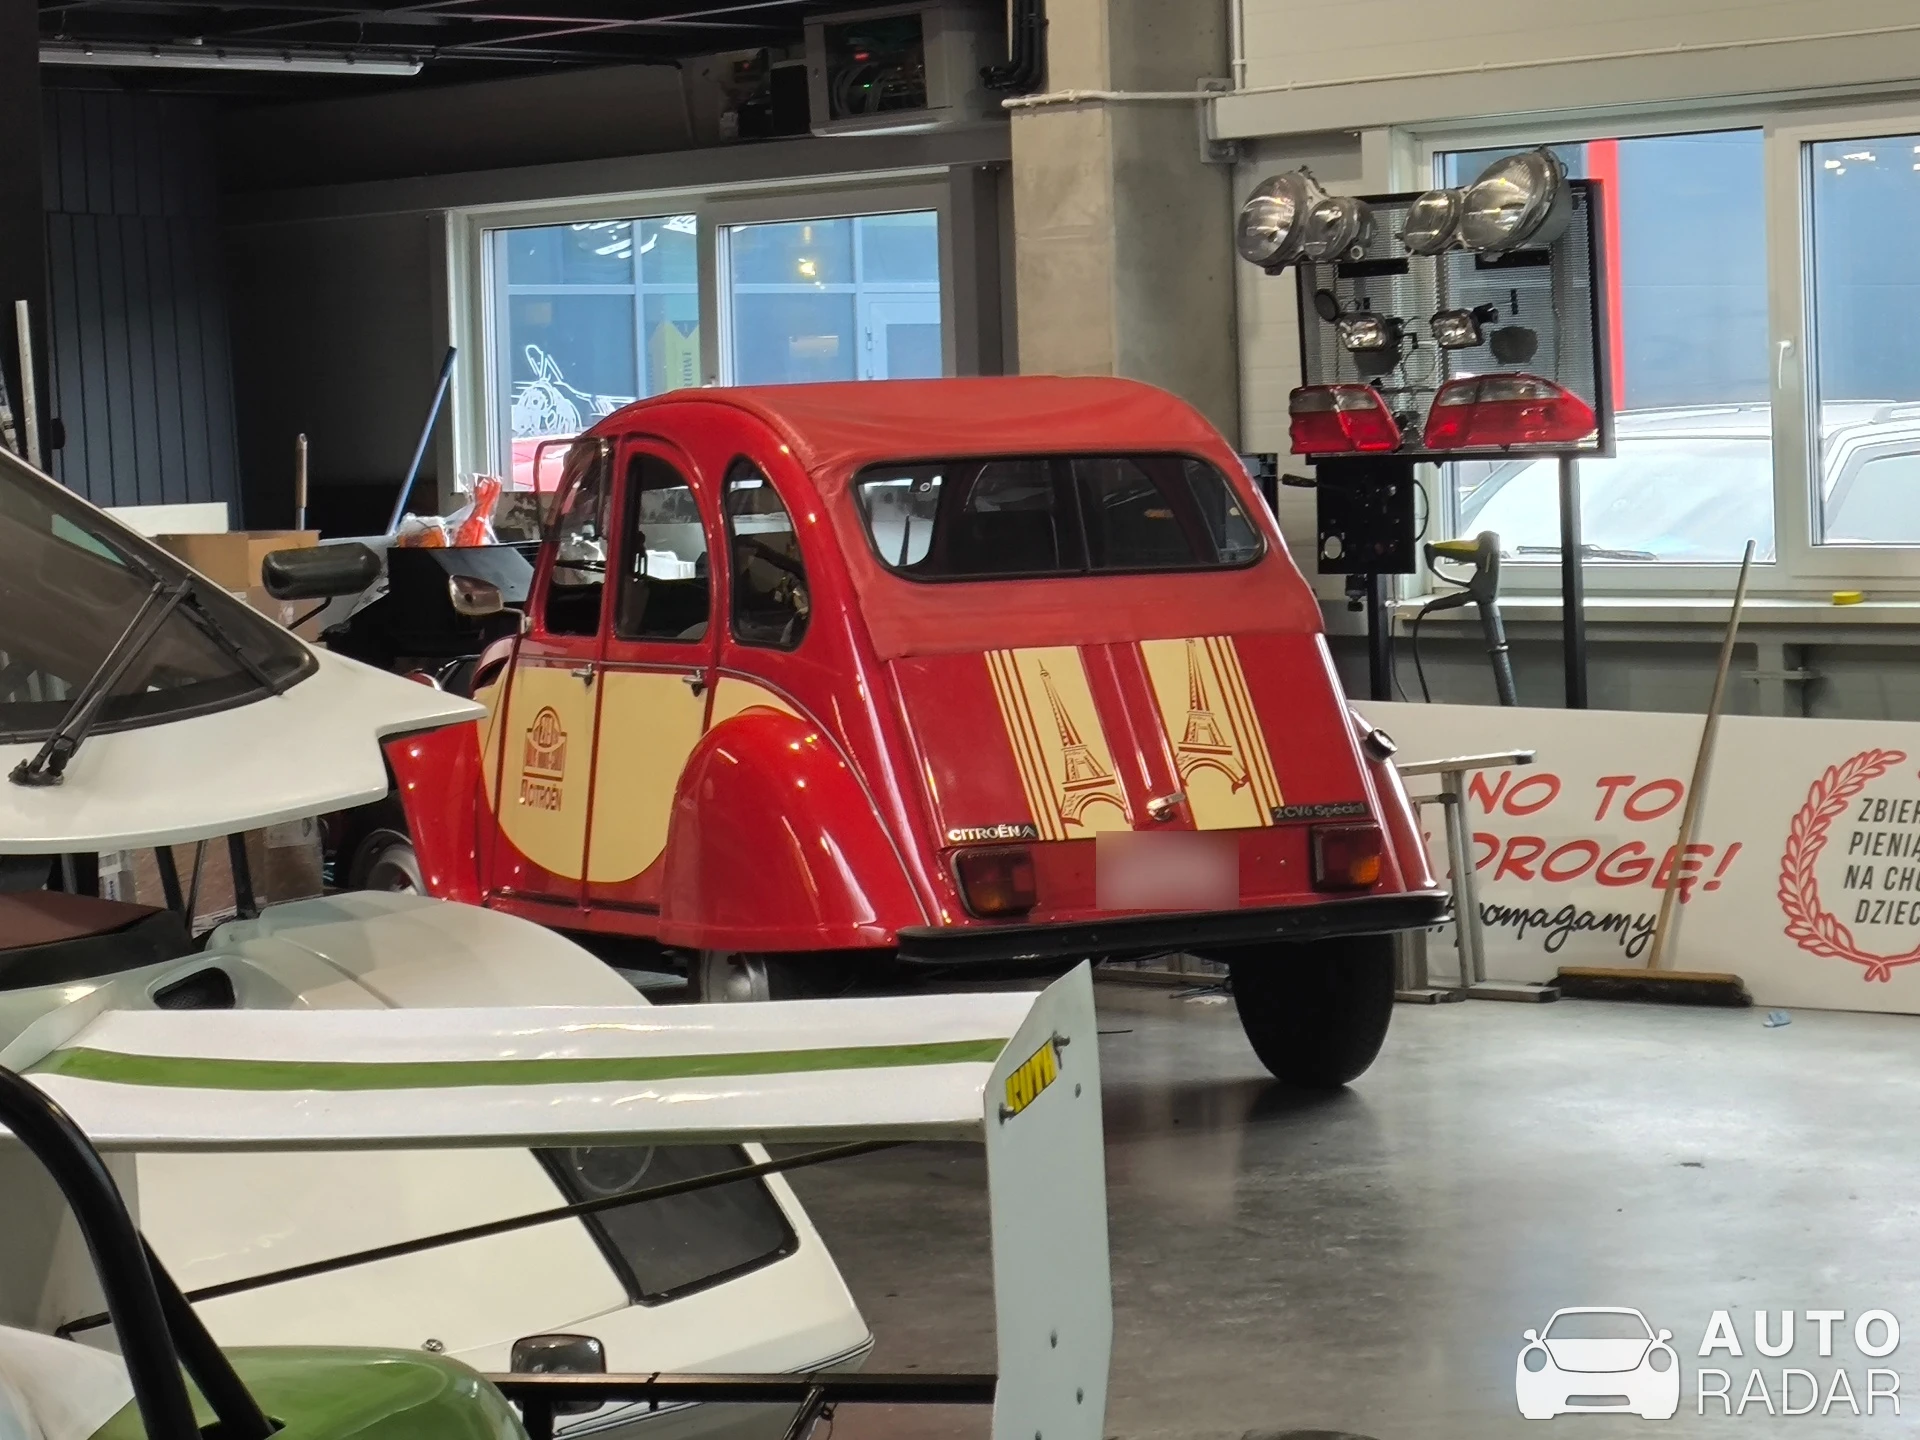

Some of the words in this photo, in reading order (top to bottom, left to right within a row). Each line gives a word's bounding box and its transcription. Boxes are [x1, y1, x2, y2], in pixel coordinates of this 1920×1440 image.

[1468, 770, 1561, 816] NO
[1595, 775, 1684, 822] TO
[1275, 806, 1313, 819] 2CV6
[948, 823, 1021, 841] CITROËN
[1843, 865, 1874, 890] NA
[1854, 899, 1920, 926] DZIEC
[1446, 896, 1657, 959] omagamy
